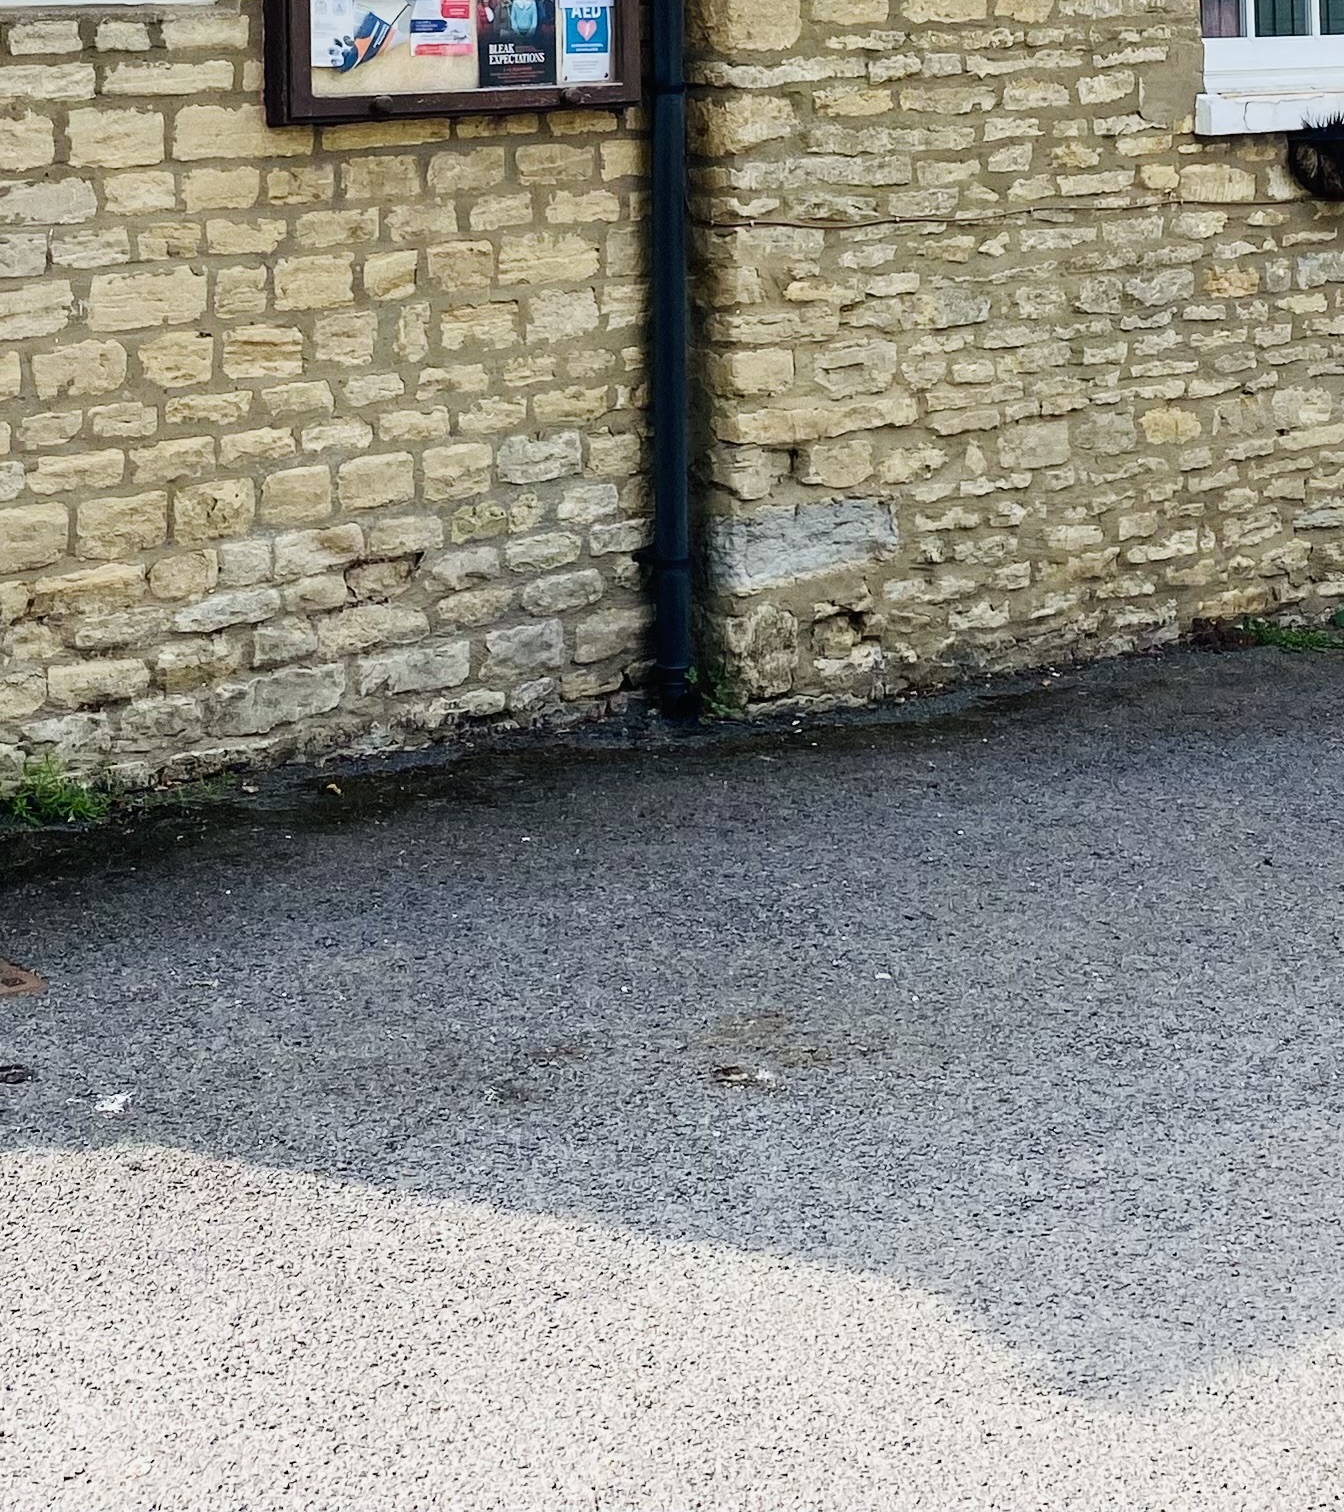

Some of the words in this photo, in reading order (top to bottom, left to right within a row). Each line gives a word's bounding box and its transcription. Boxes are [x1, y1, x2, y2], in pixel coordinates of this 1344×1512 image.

[571, 7, 602, 19] AED
[488, 43, 515, 54] BLEAK
[489, 52, 545, 65] EXPECTATIONS
